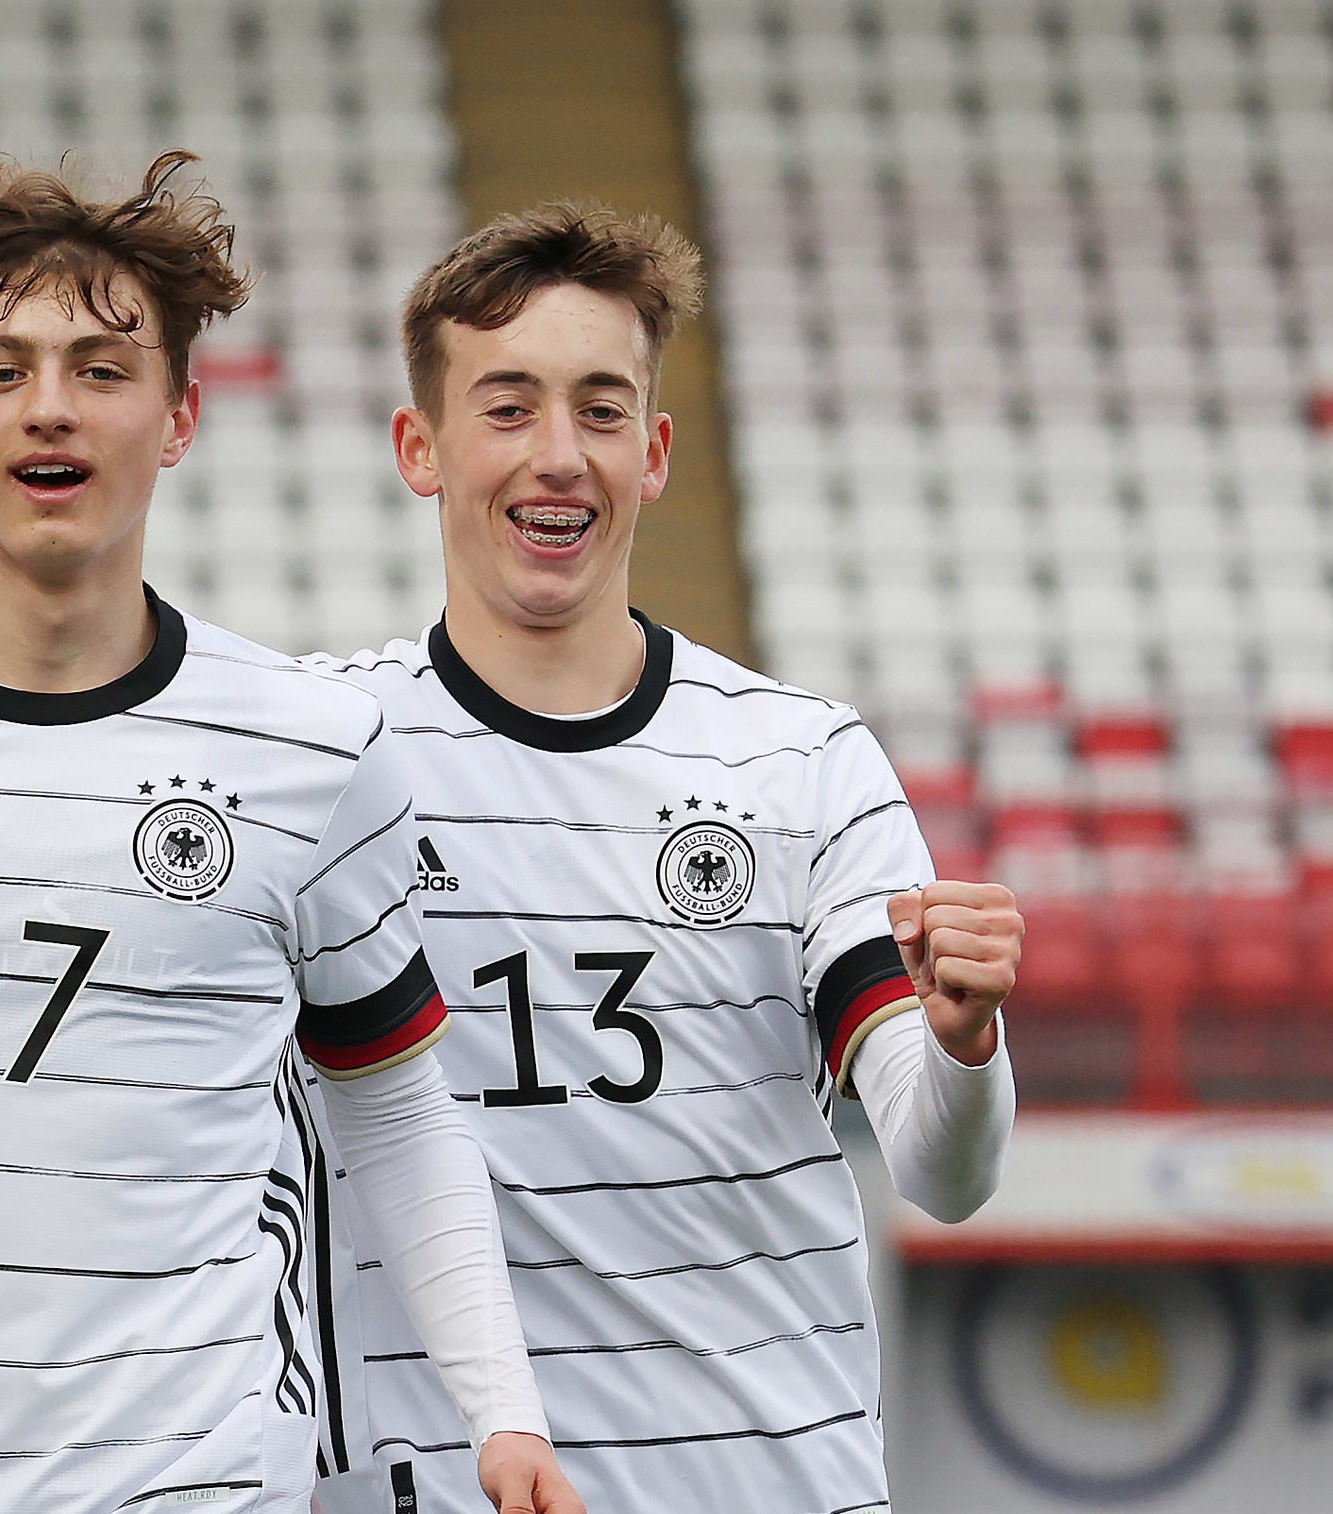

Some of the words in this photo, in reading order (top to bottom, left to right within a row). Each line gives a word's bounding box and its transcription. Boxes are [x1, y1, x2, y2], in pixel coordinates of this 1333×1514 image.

[158, 811, 216, 834] DEUTSCHER
[677, 834, 736, 854] DEUTSCHER
[418, 871, 460, 892] das
[473, 949, 664, 1108] 13
